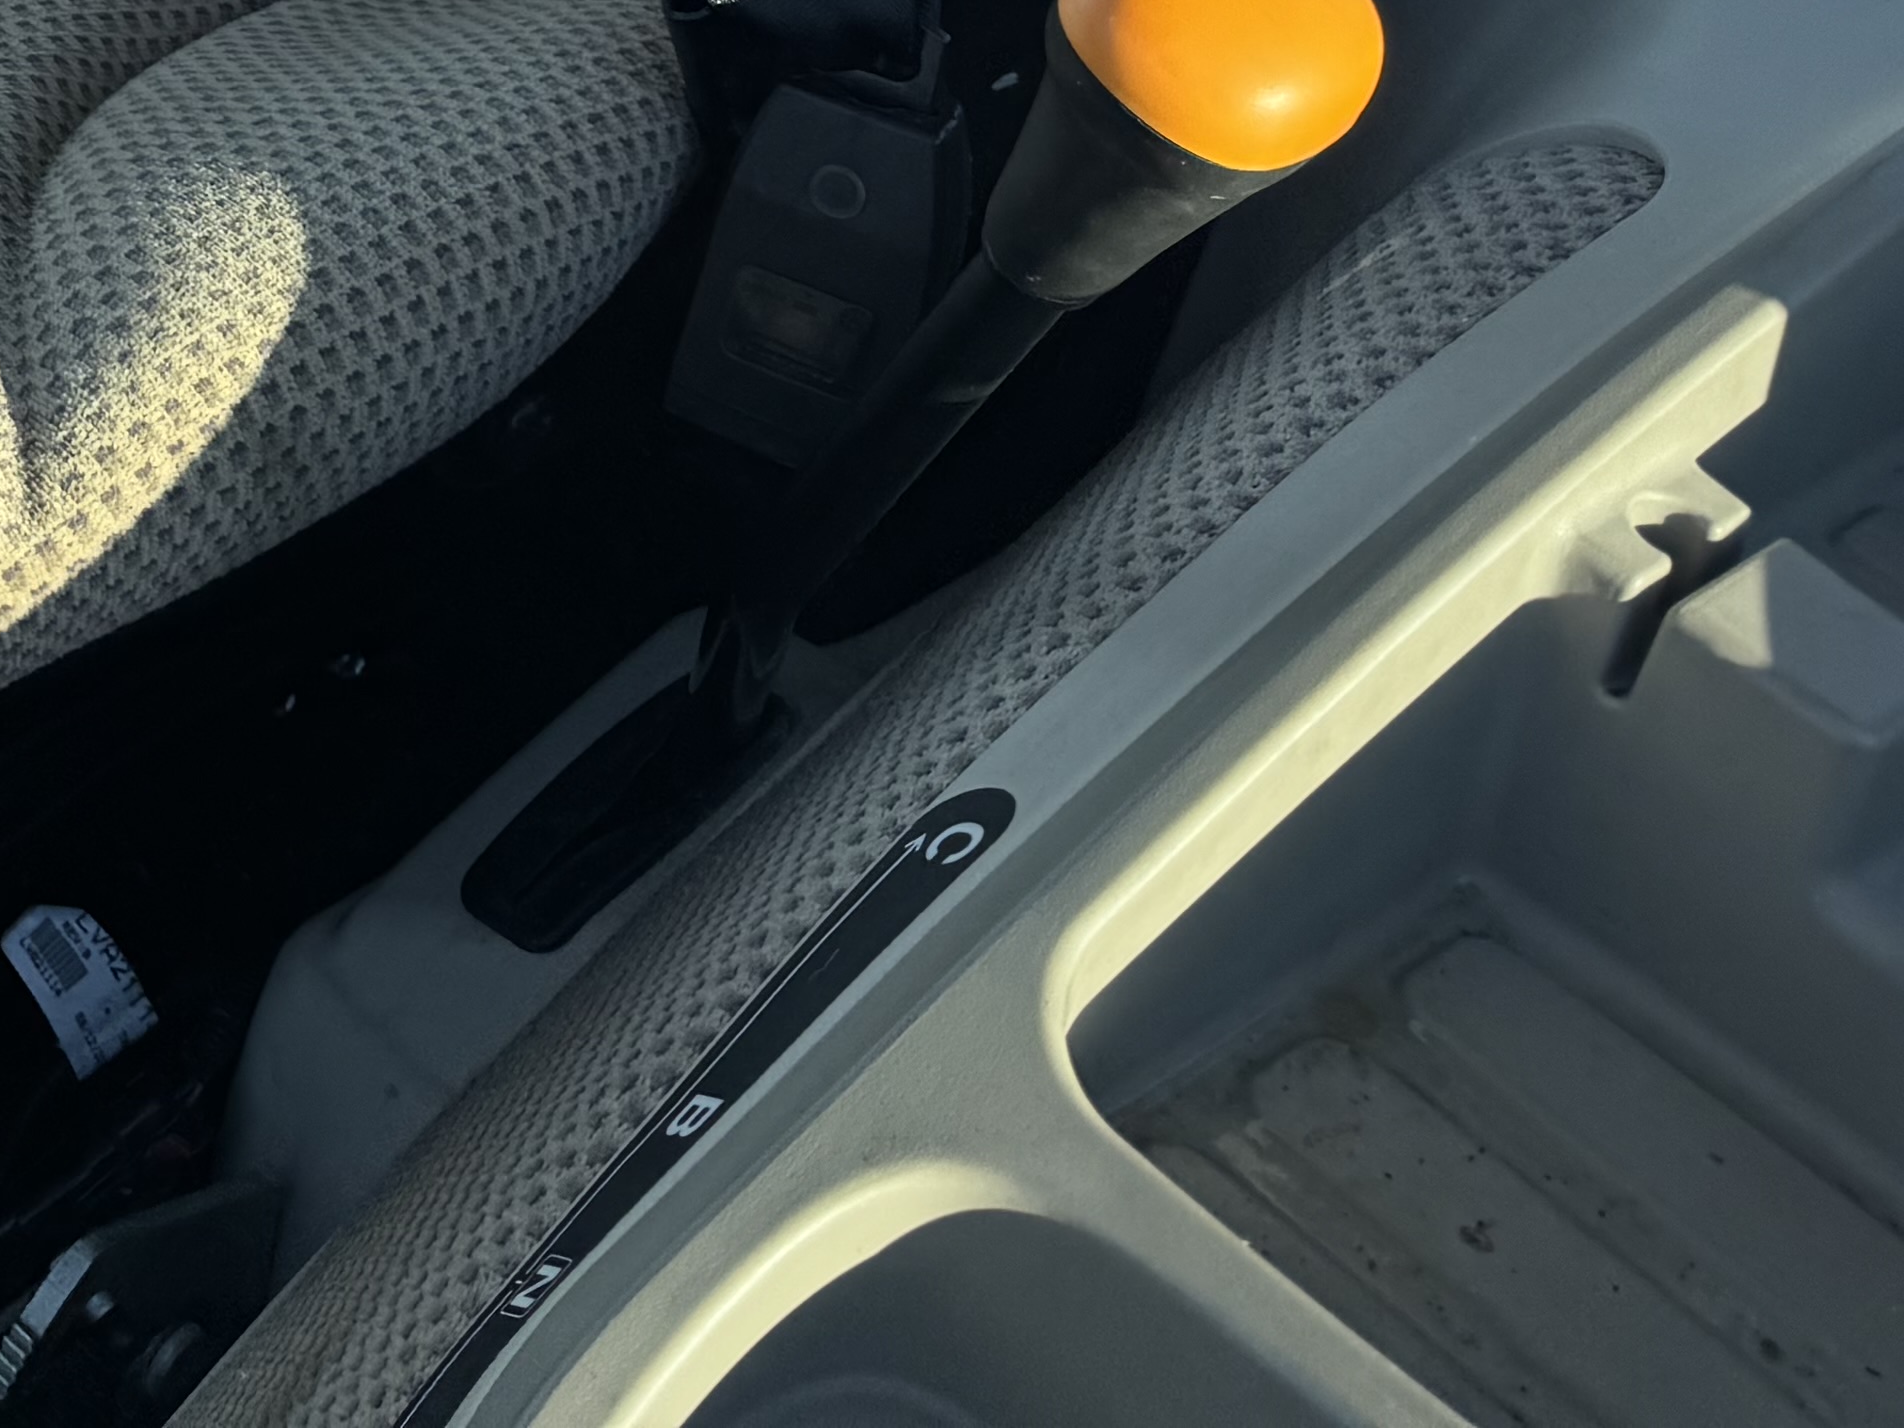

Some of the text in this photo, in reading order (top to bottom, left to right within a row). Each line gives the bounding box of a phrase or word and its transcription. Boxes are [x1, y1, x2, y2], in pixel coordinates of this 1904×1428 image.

[925, 821, 985, 865] C
[74, 911, 154, 1022] LVA2111
[665, 1093, 725, 1138] B
[510, 1264, 562, 1309] N
